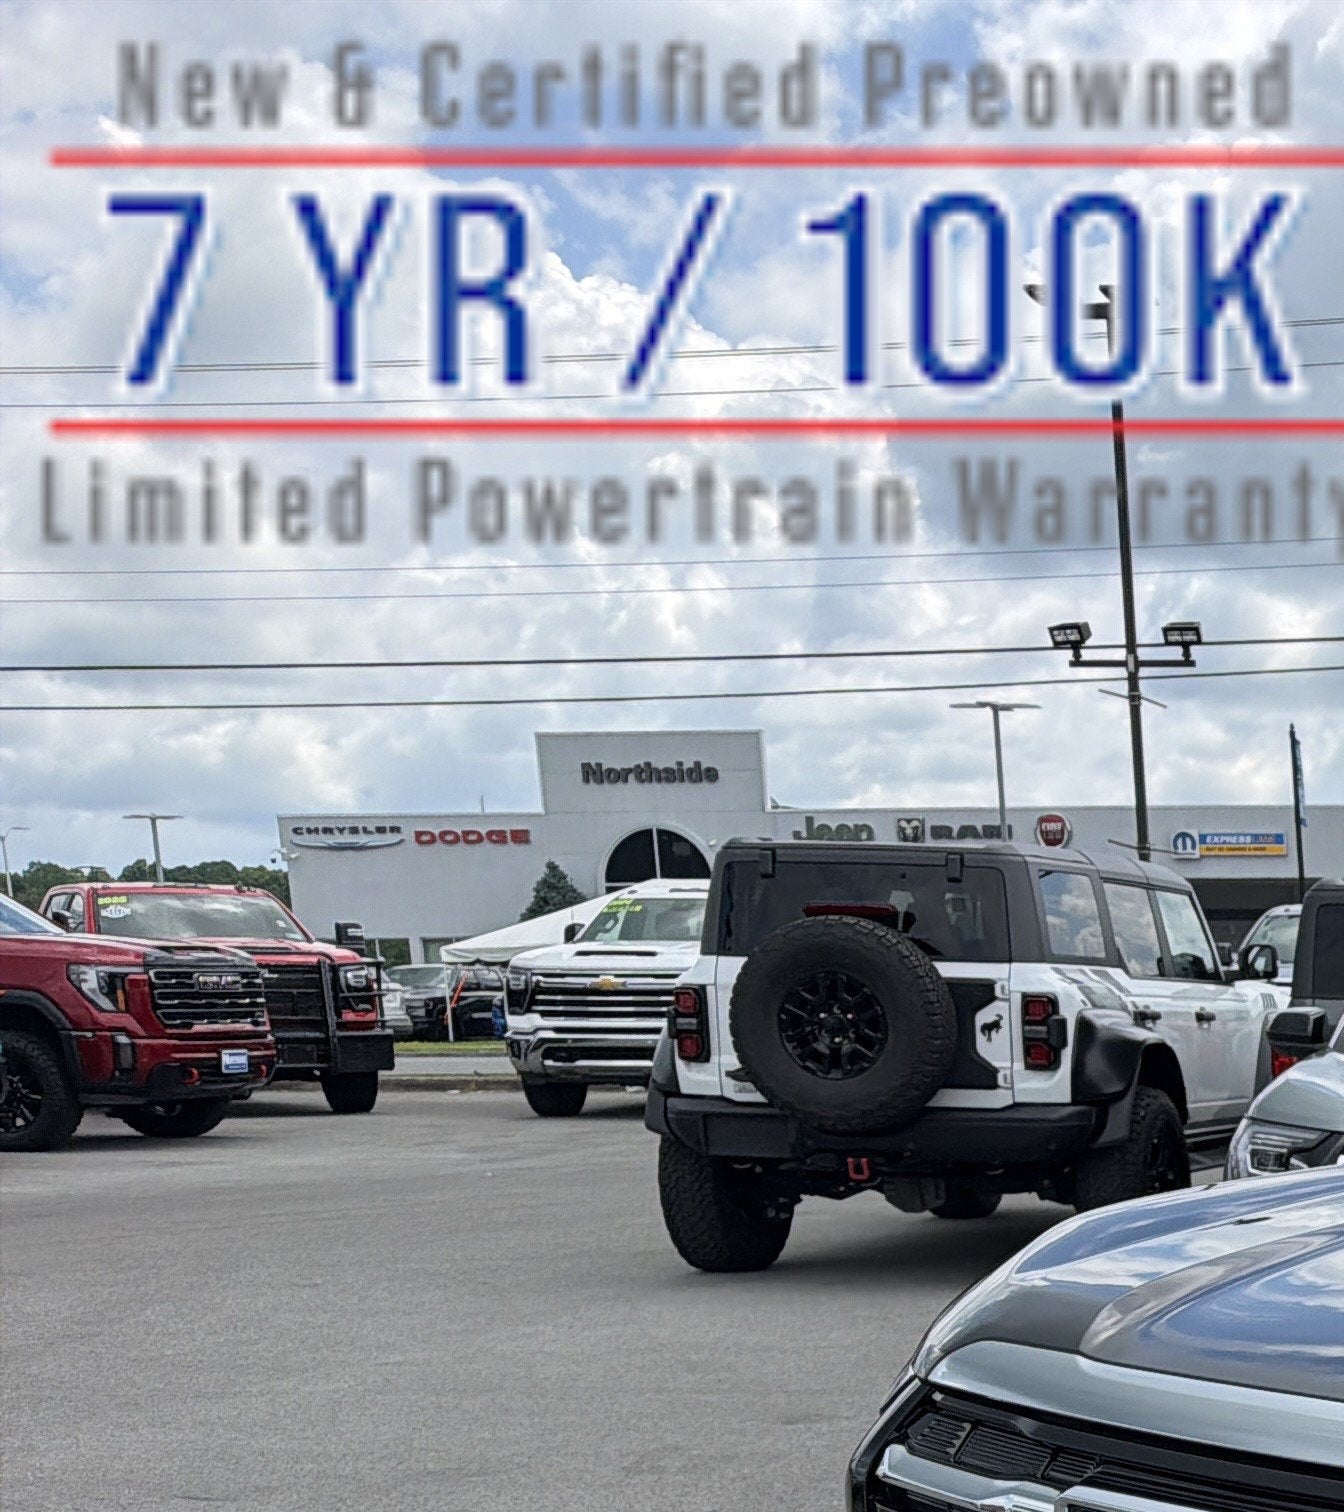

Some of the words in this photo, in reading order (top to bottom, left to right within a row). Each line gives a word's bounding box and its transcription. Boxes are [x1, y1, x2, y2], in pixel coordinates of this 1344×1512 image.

[580, 761, 719, 785] Northside
[291, 825, 402, 836] CHRYSLER
[414, 829, 532, 845] DODGE
[1205, 835, 1252, 844] EXPRESS
